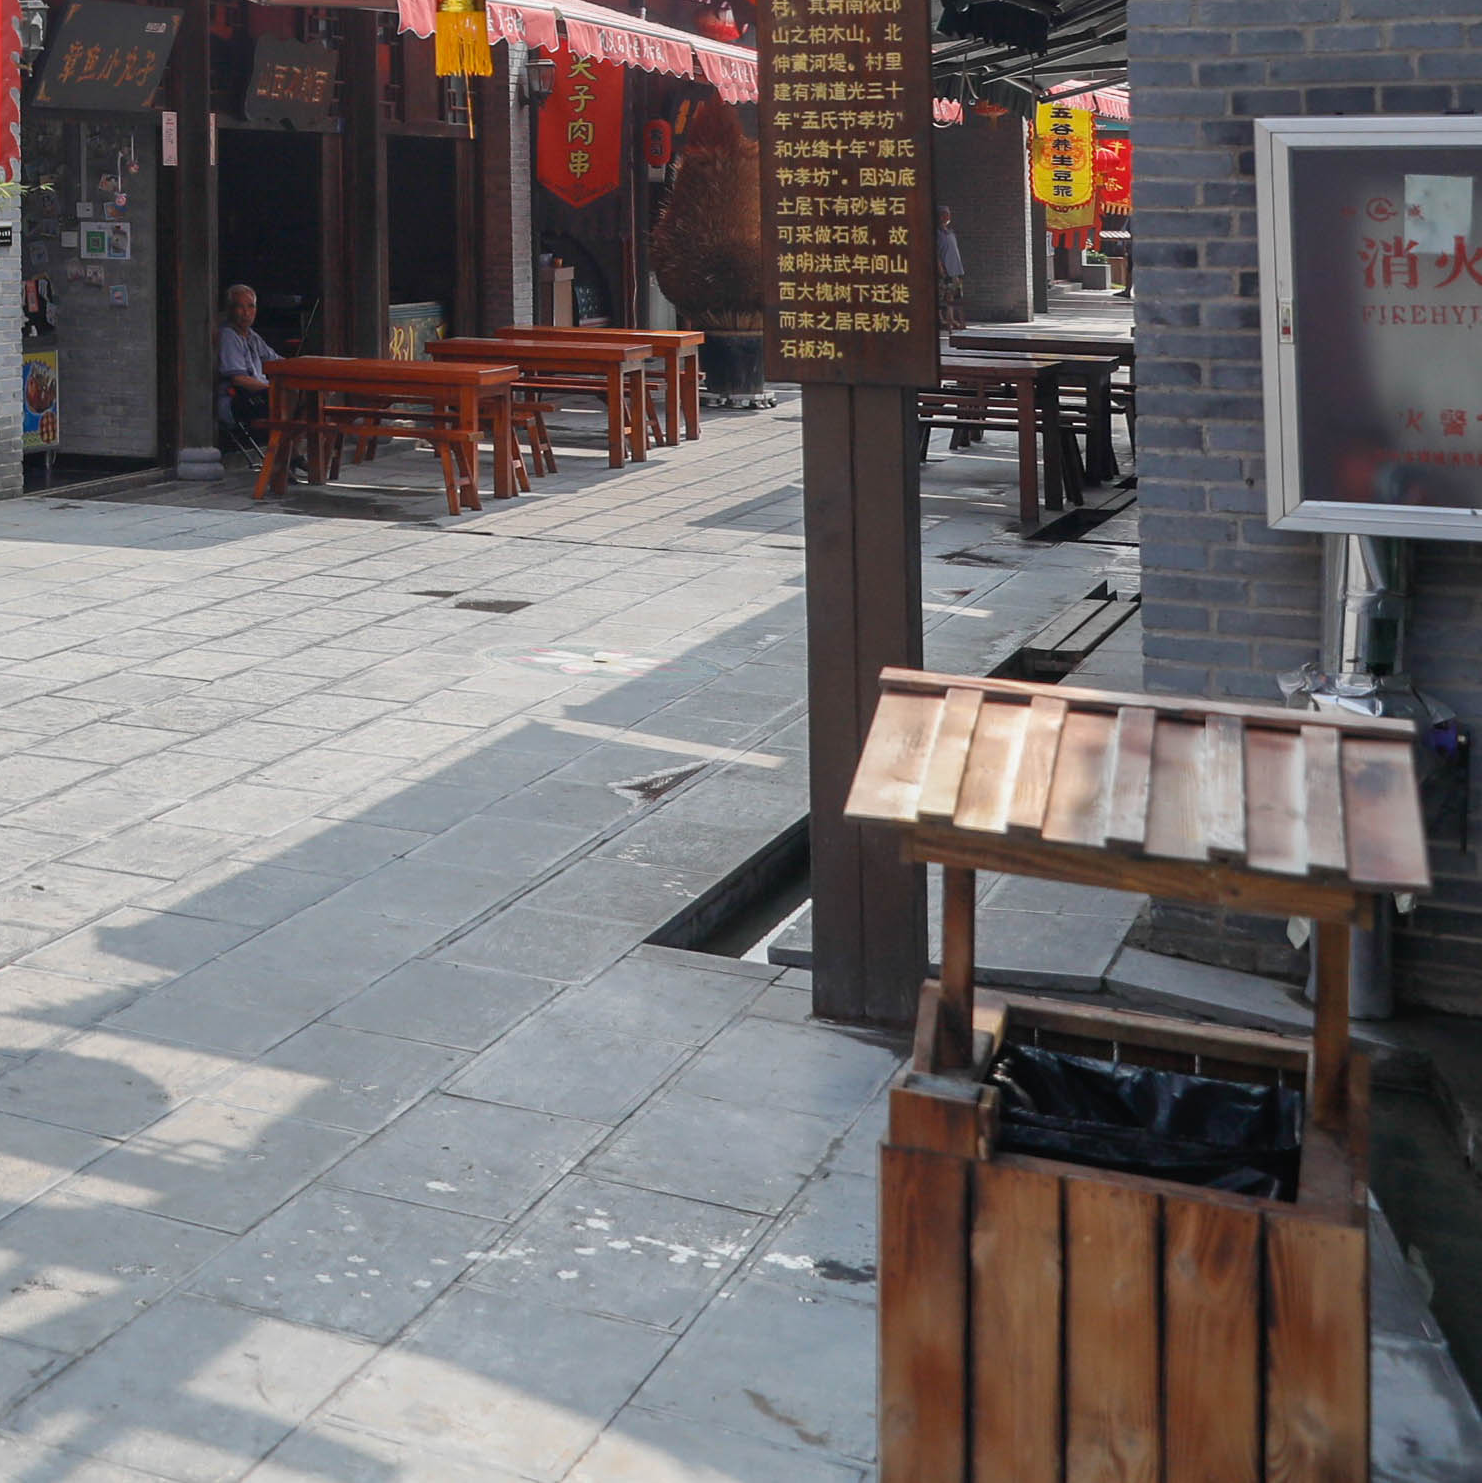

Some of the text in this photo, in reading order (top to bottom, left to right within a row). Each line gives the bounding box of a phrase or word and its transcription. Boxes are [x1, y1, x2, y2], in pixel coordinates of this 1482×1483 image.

[772, 23, 903, 44] 山之柏木山，北
[773, 81, 904, 101] 建有清道光三十
[1050, 107, 1073, 197] 五谷养生豆浆
[777, 196, 907, 216] 土层下有砂岩石
[777, 225, 908, 246] 可采做石板，故
[777, 251, 908, 274] 被明洪武年间山
[1357, 236, 1482, 289] 消火
[778, 281, 910, 304] 西大槐树下迁徙
[779, 311, 910, 333] 而来之居民称为
[780, 339, 844, 360] 石板沟。
[1396, 408, 1482, 437] 火警
